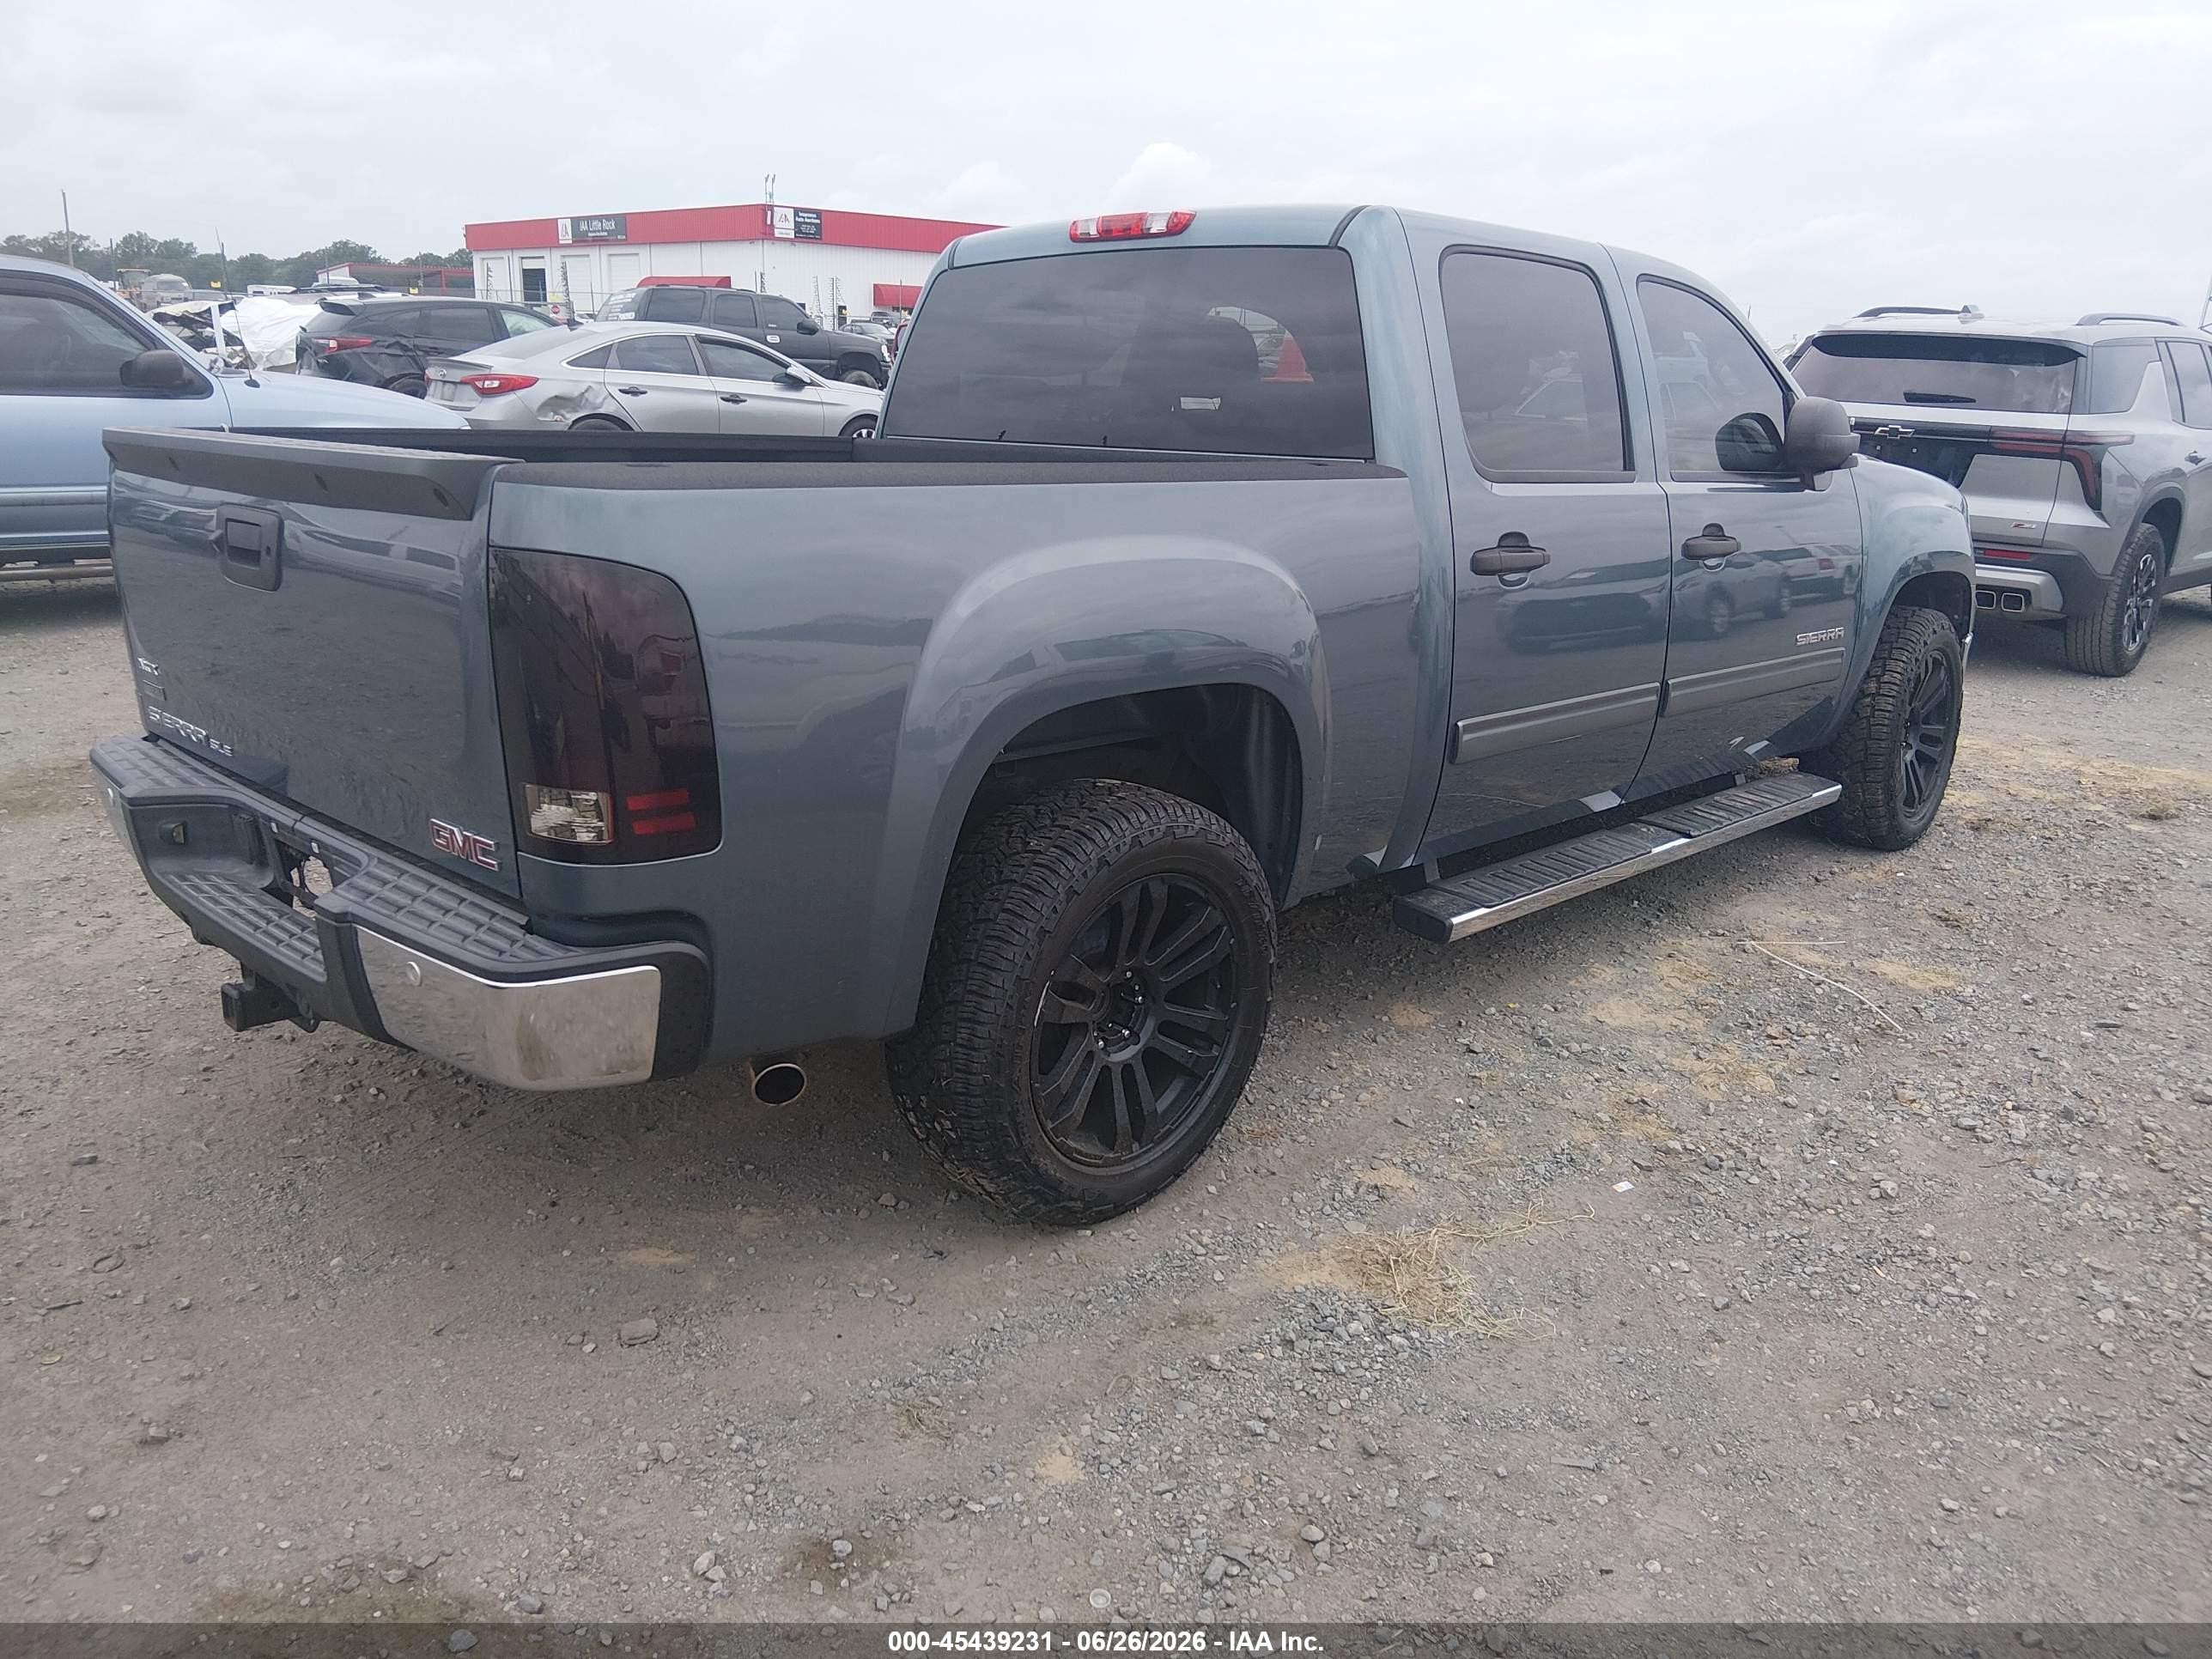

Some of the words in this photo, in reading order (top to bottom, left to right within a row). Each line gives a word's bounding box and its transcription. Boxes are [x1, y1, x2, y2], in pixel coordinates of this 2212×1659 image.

[588, 219, 601, 231] Little
[603, 219, 615, 230] Rock
[1796, 626, 1845, 647] SIERRA
[148, 705, 209, 746] SIERRA
[429, 817, 500, 872] GMC
